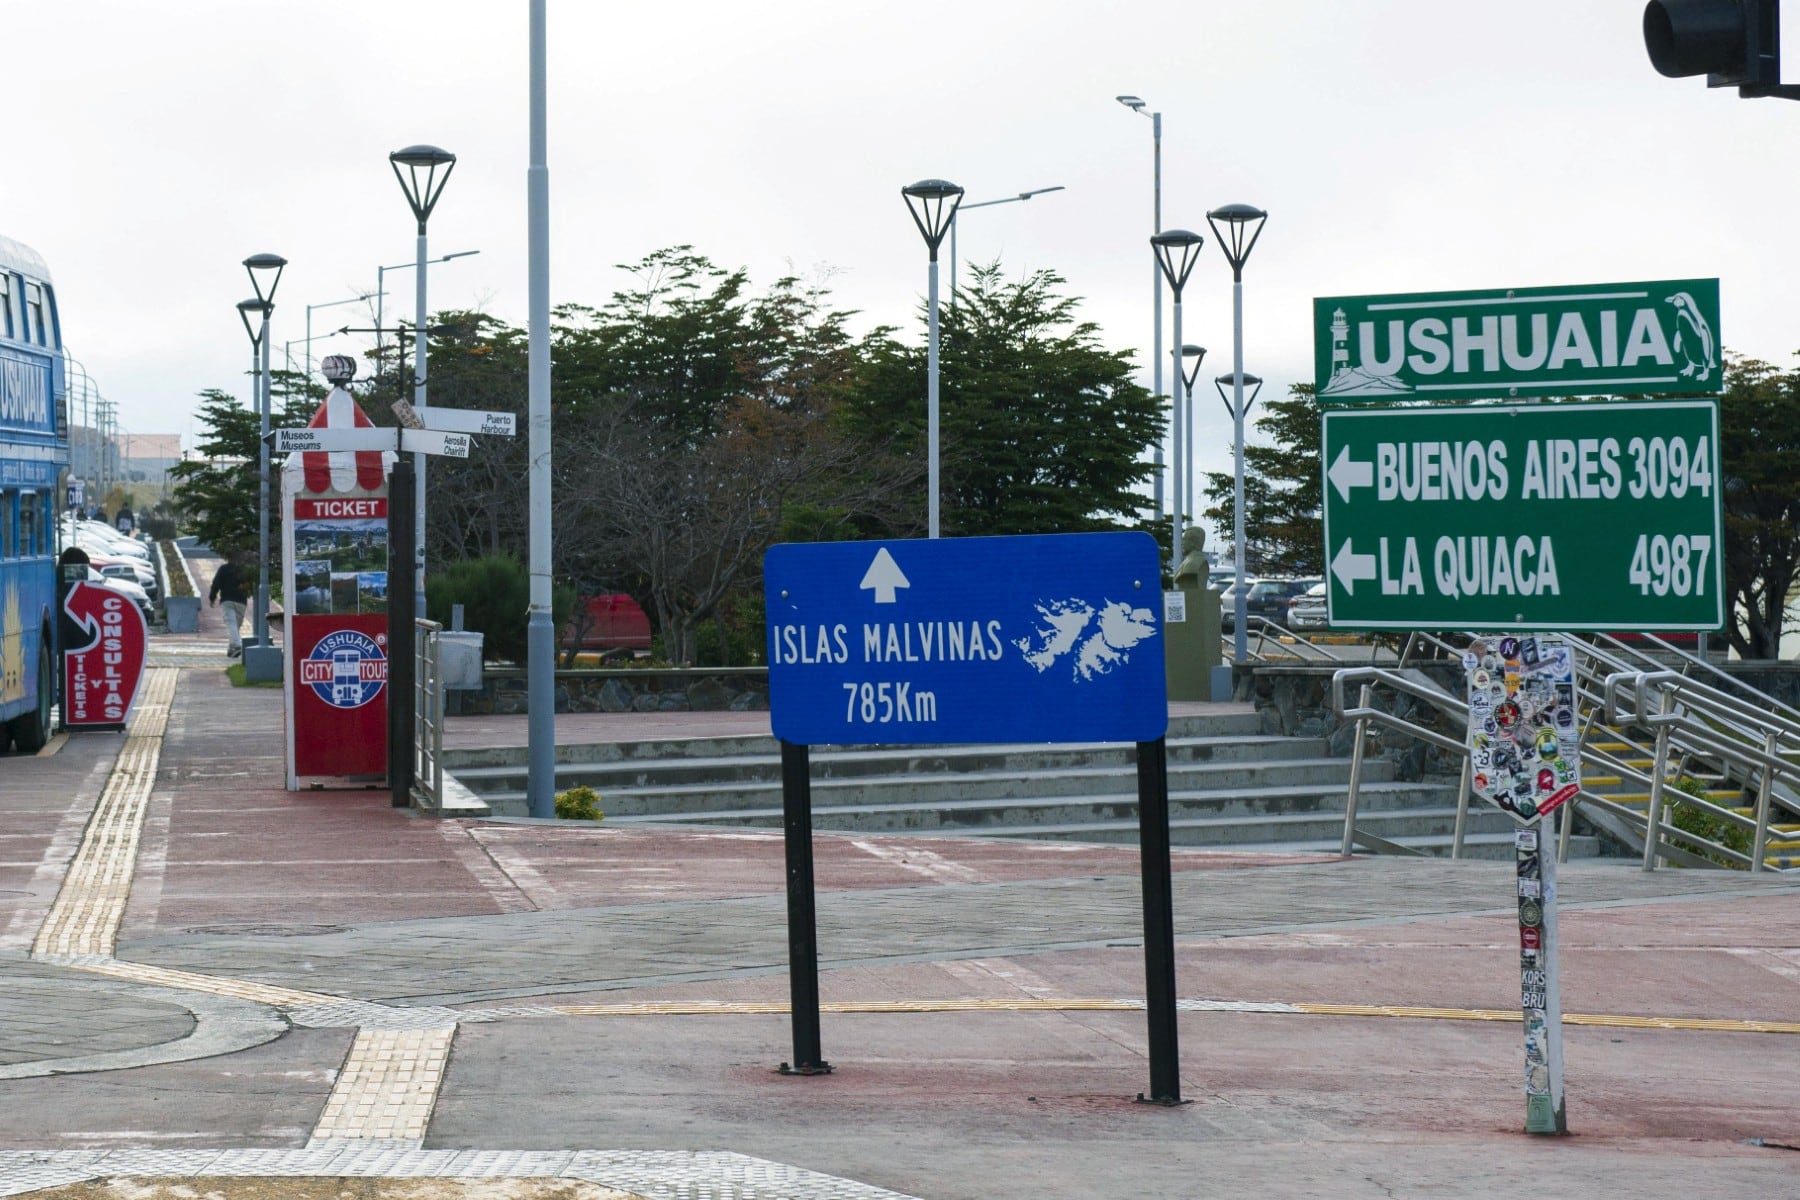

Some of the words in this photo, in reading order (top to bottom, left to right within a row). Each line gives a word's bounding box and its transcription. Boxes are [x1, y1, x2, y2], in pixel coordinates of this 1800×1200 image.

[1358, 308, 1674, 377] USHUAIA
[0, 358, 47, 423] USHUAIA
[486, 414, 511, 426] Puerto
[281, 431, 314, 441] Museos
[480, 424, 511, 434] Harbour
[280, 441, 321, 451] Museums
[443, 434, 467, 447] Aerosilla
[443, 445, 466, 457] Chairlift
[1376, 440, 1509, 501] BUENOS
[1521, 438, 1622, 500] AIRES
[1628, 436, 1712, 498] 3094
[313, 501, 379, 517] TICKET
[1379, 536, 1424, 595] LA
[1433, 535, 1560, 600] QUIACA
[1629, 534, 1711, 596] 4987
[319, 633, 375, 654] USHUAIA
[773, 624, 848, 664] ISLAS
[863, 619, 1003, 662] MALVINAS
[102, 598, 123, 719] CONSULTAS
[305, 663, 333, 680] CITY
[74, 655, 87, 718] TICKETS
[90, 680, 102, 689] Y
[843, 682, 937, 723] 785Km
[1522, 992, 1545, 1009] BRU
